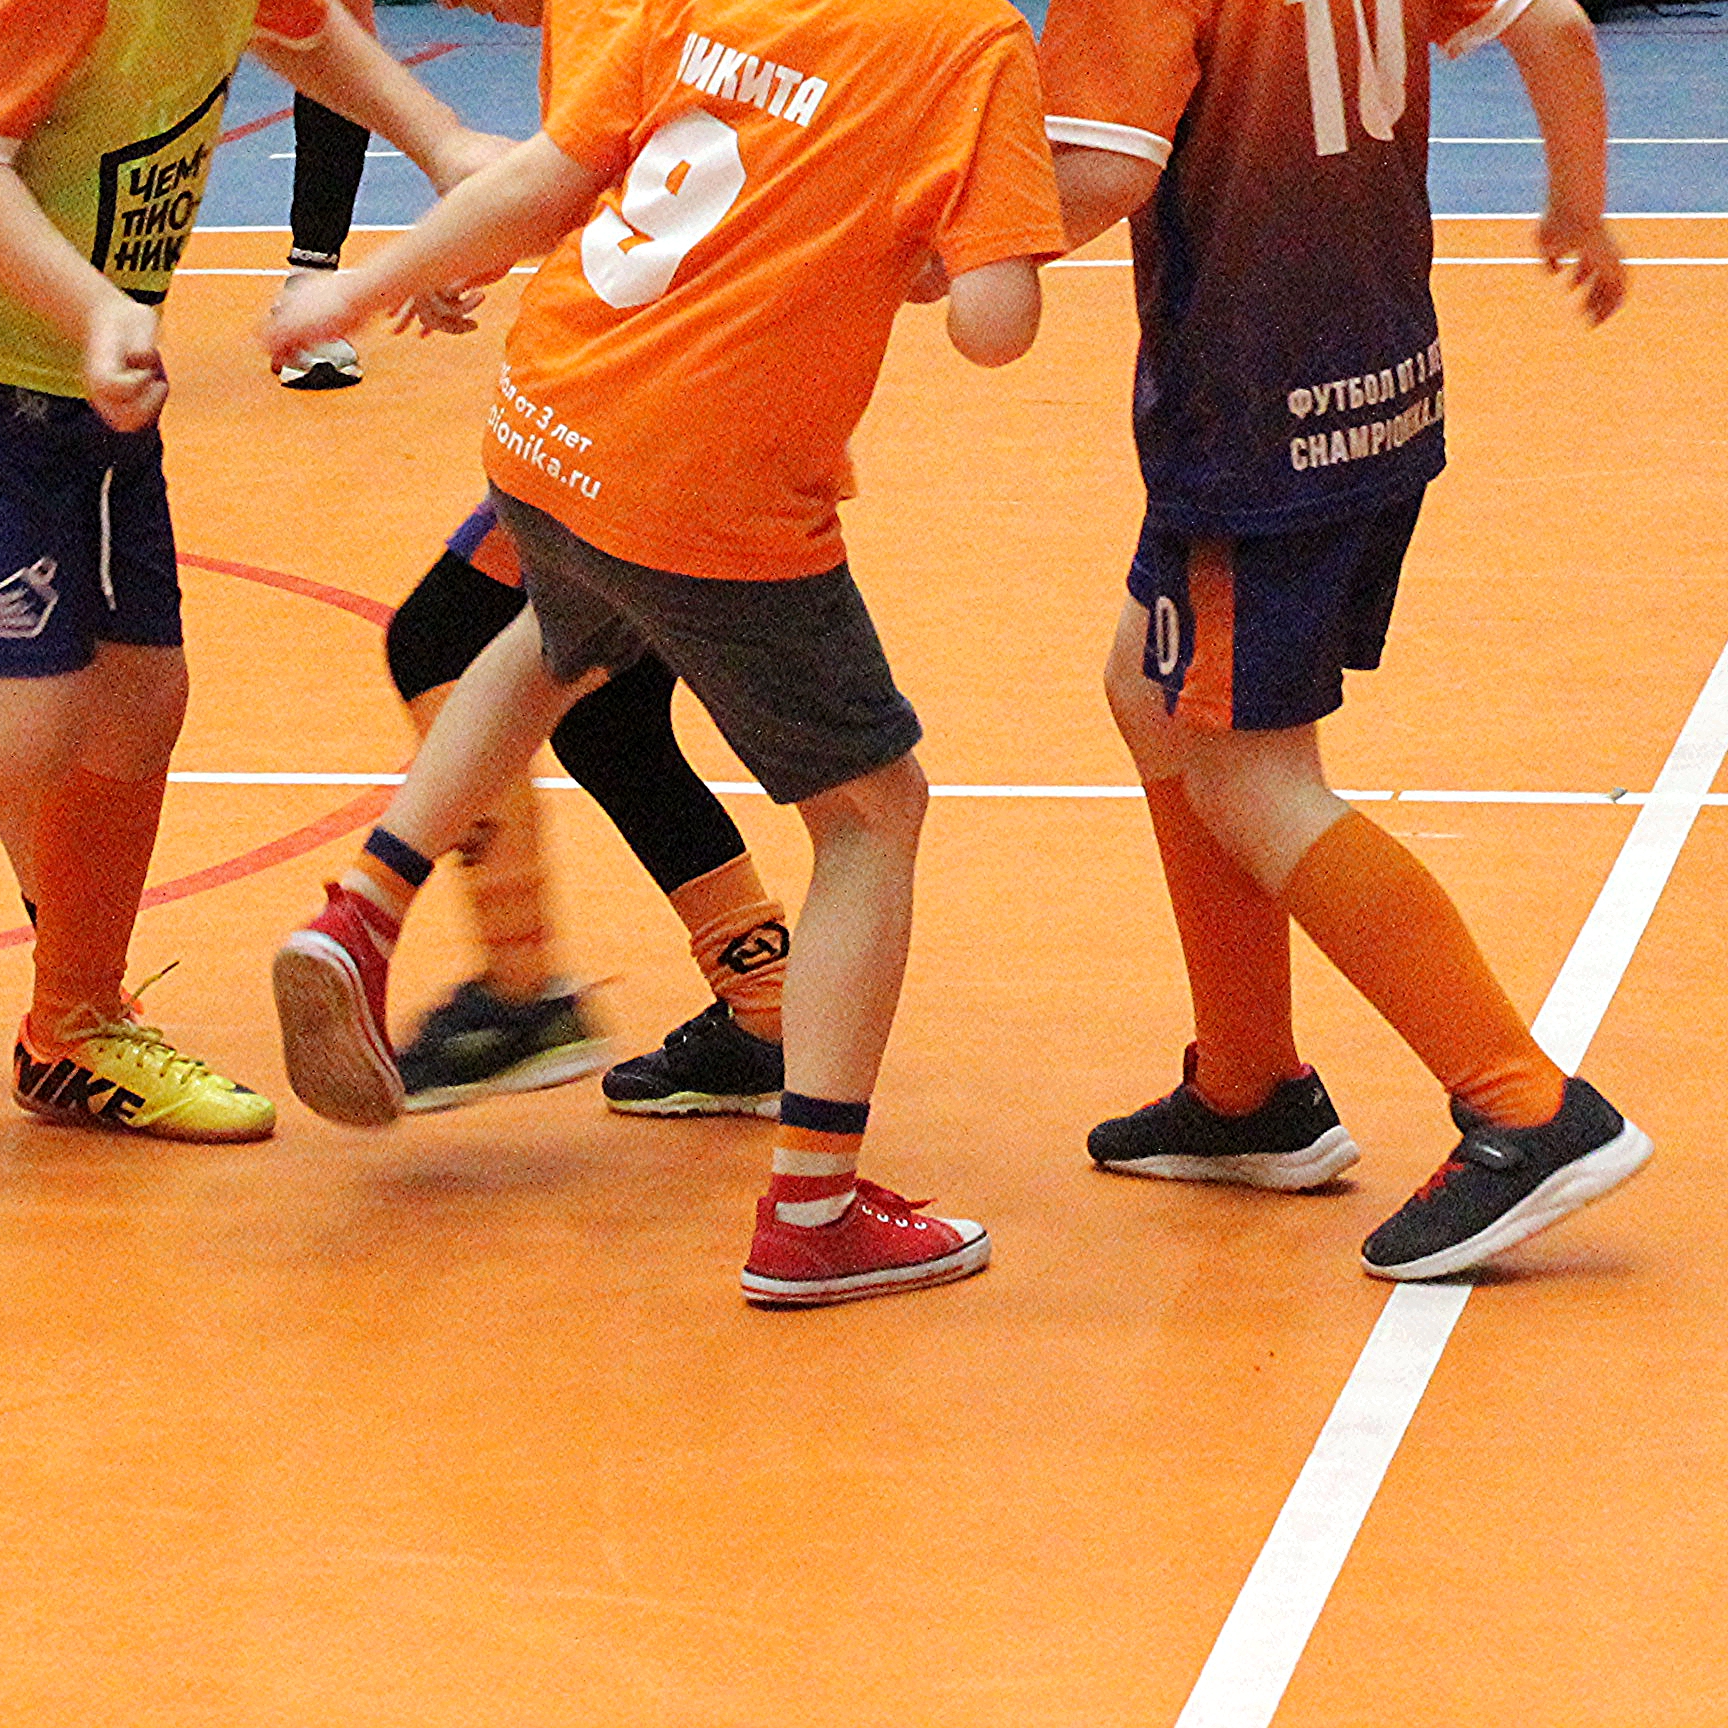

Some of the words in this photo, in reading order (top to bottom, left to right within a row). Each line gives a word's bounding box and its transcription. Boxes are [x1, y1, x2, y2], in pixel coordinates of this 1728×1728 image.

[581, 104, 746, 309] 9
[515, 395, 537, 418] от
[536, 405, 554, 430] 3
[550, 423, 593, 453] лет
[1287, 368, 1396, 420] ФУТБОЛ
[15, 1041, 147, 1122] NIKE
